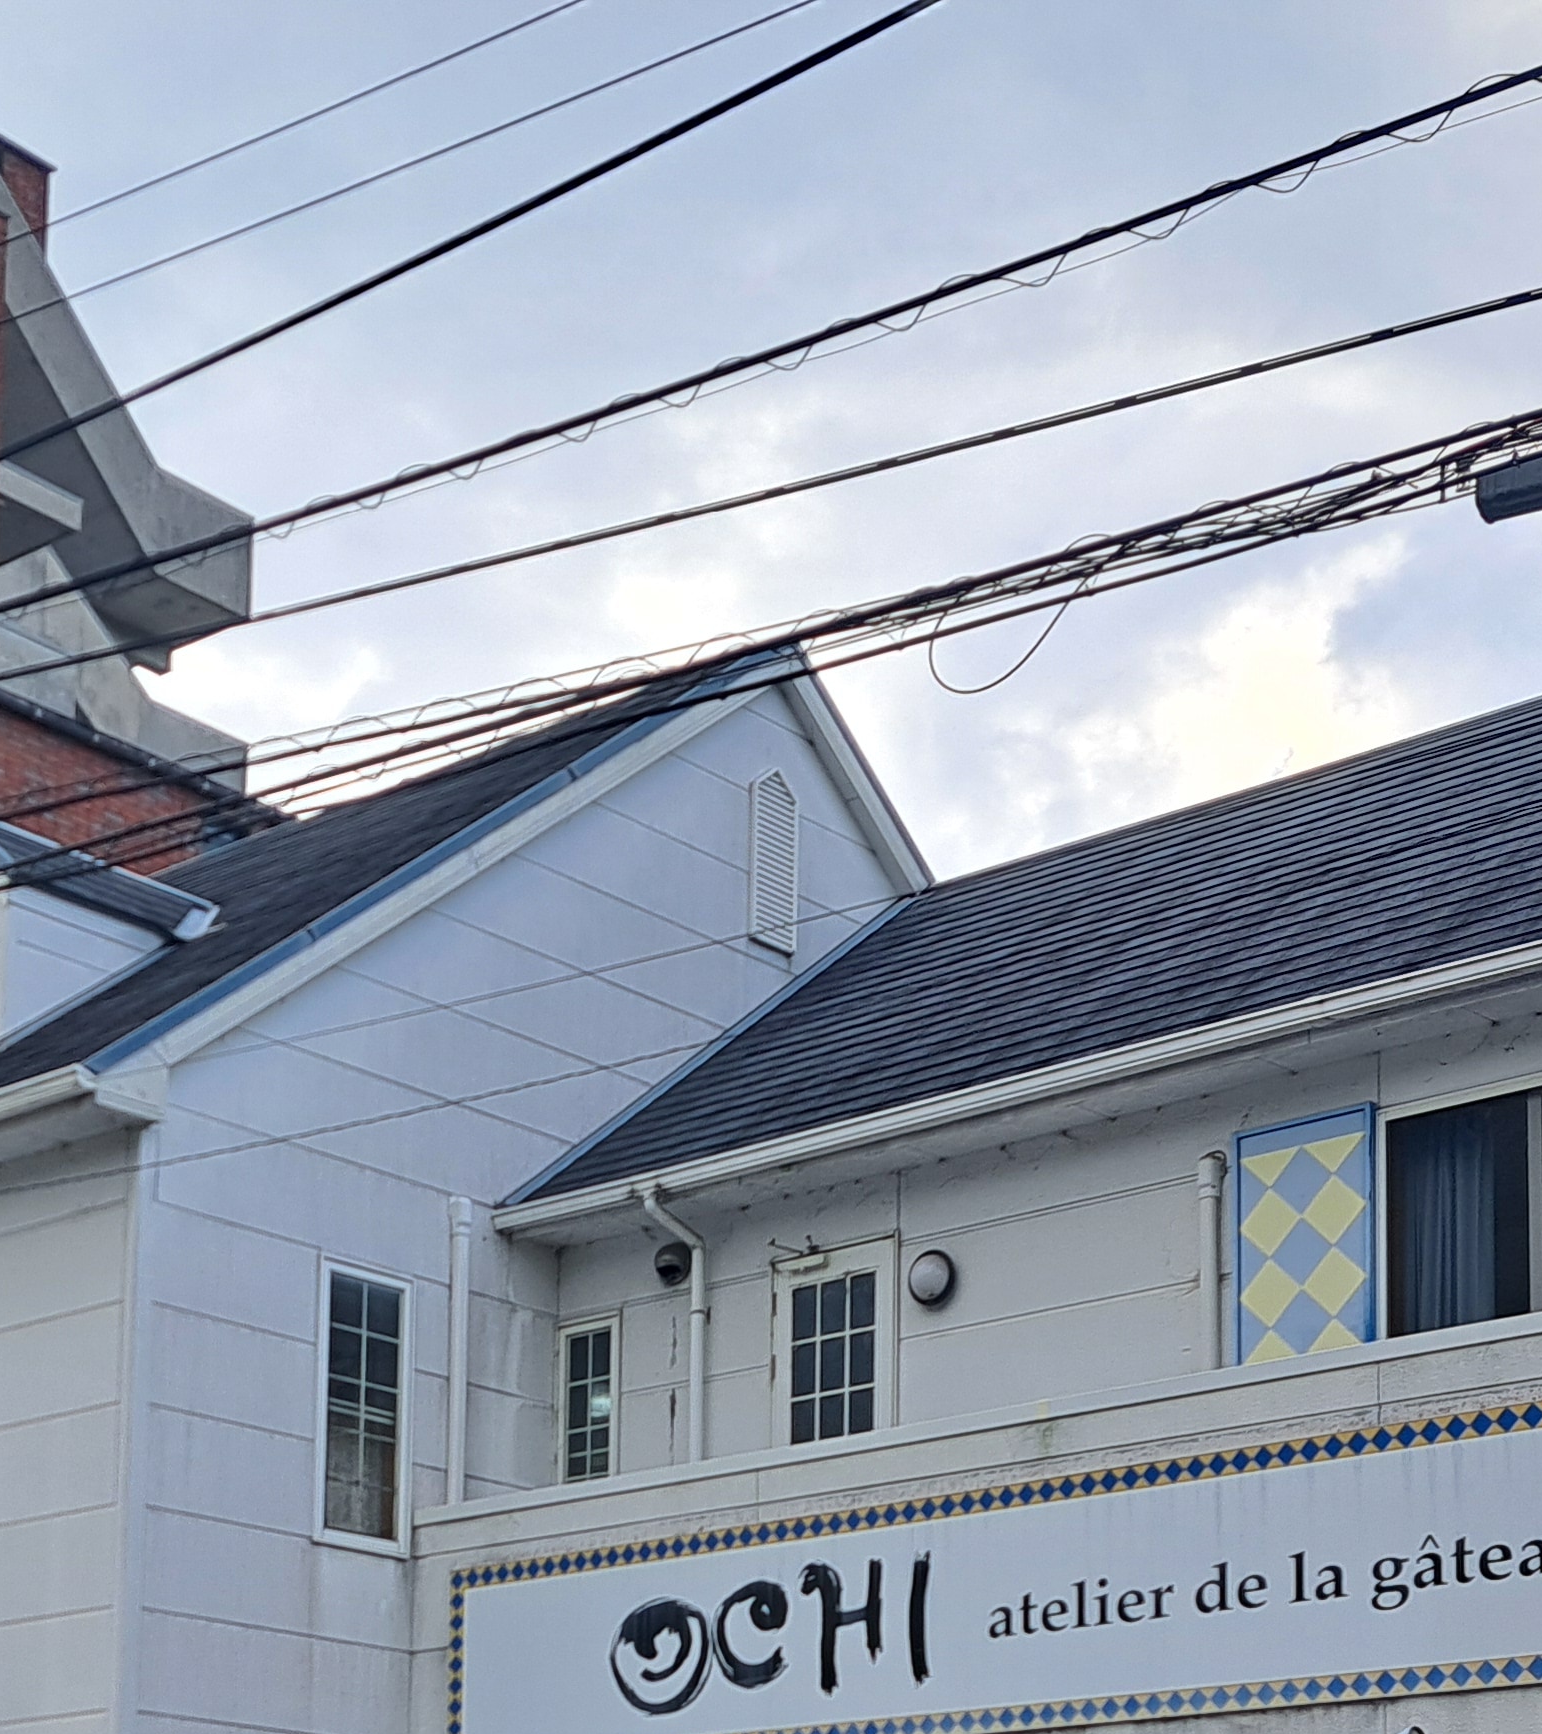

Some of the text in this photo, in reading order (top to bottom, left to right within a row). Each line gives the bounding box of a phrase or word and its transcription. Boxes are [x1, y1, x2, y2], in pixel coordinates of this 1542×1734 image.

[610, 1549, 934, 1717] OCHI
[988, 1578, 1175, 1639] atelier
[1195, 1562, 1268, 1614] de
[1288, 1551, 1348, 1605] la
